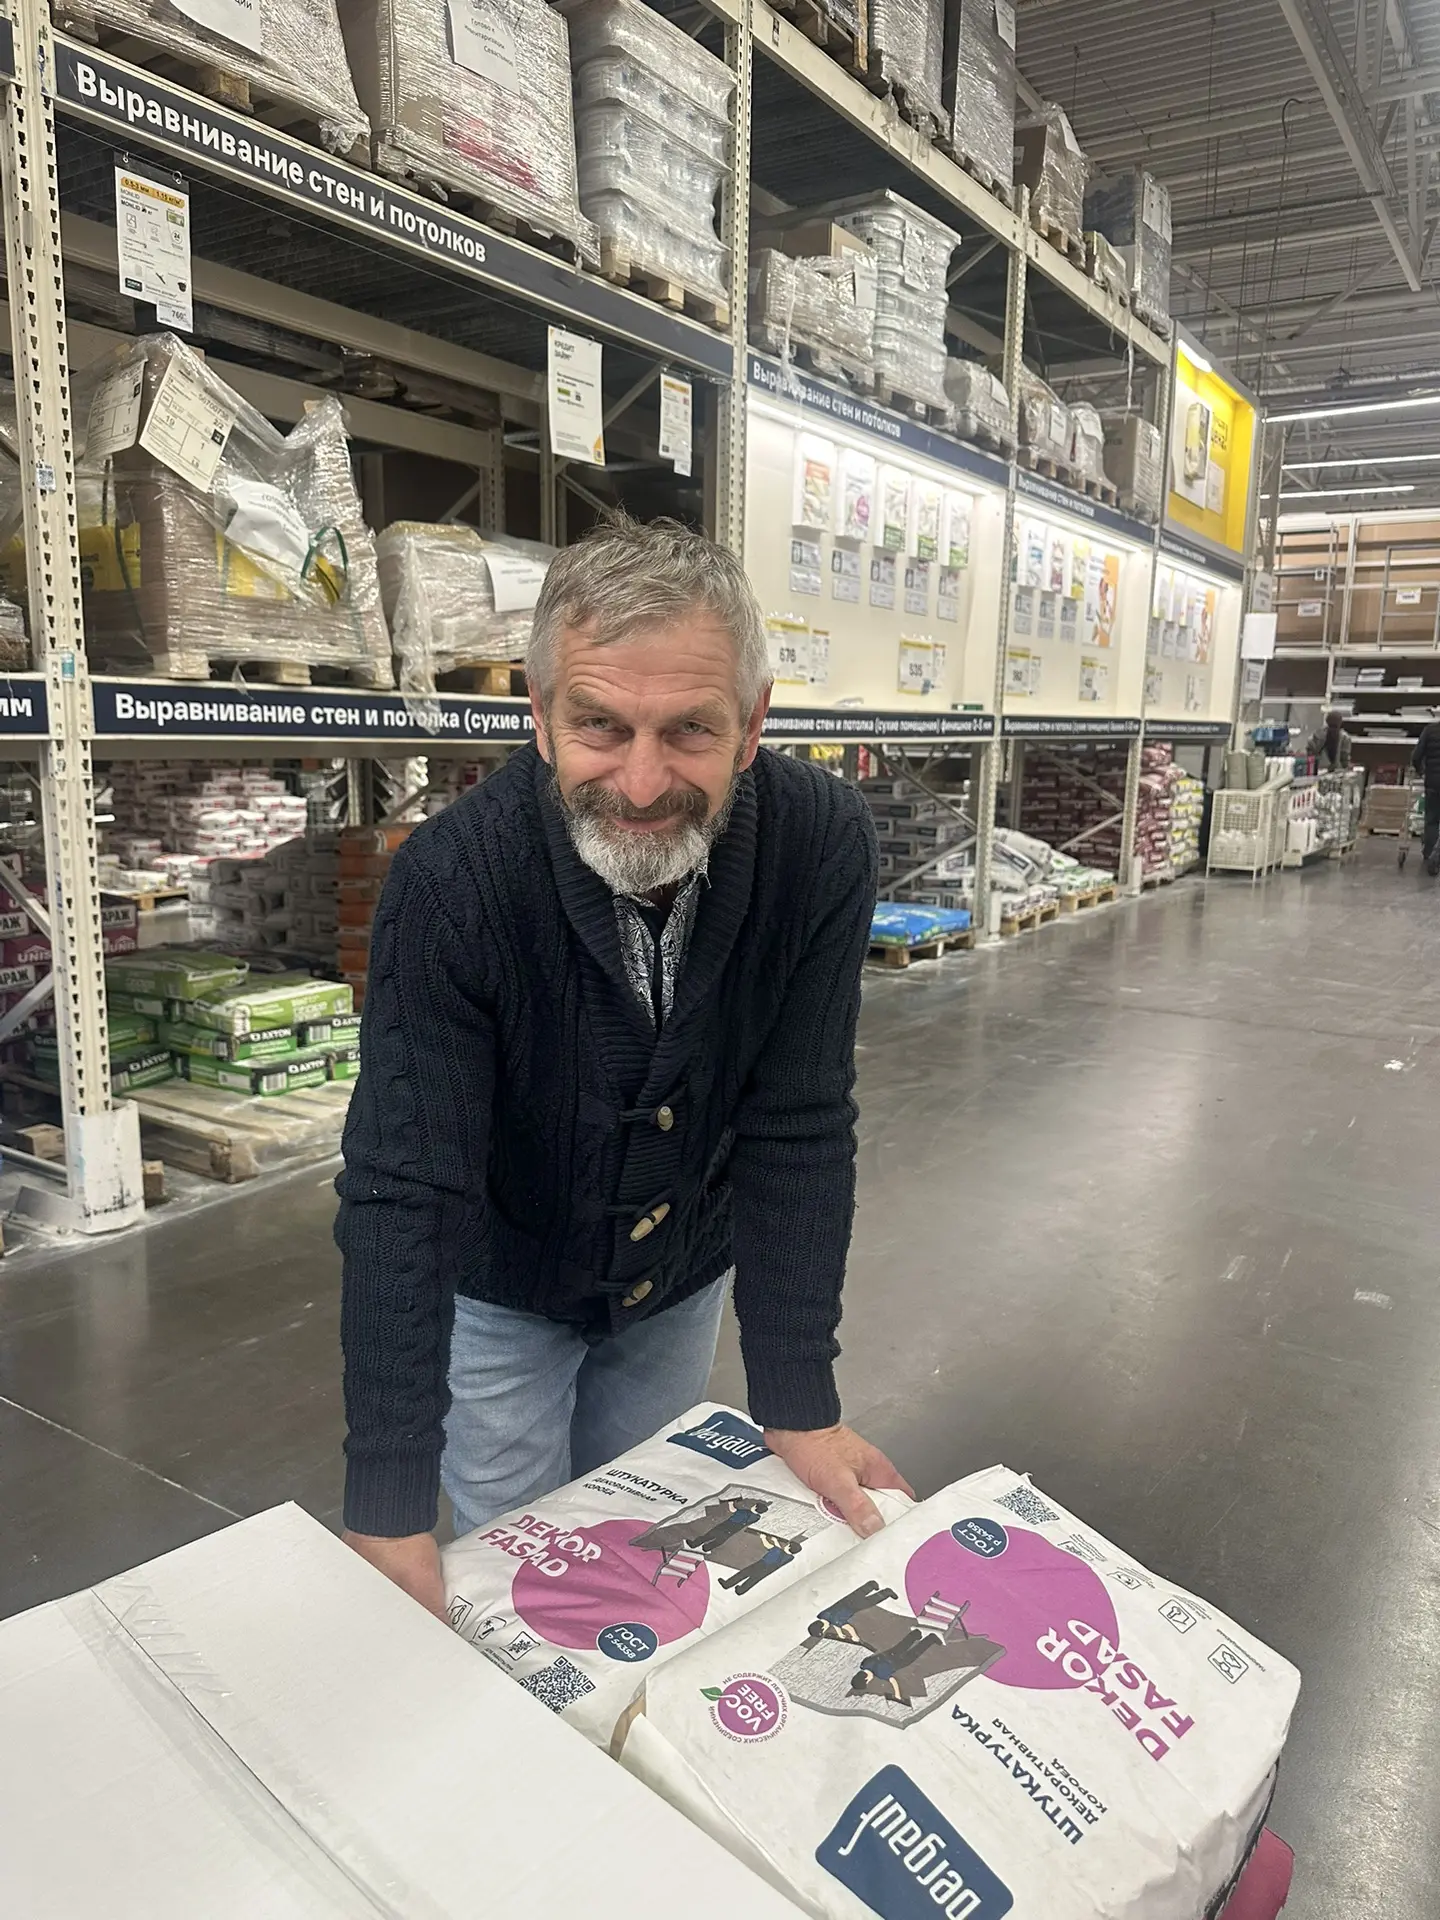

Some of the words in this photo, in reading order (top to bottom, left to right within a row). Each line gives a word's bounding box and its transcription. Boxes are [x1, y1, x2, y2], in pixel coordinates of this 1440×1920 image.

[76, 60, 304, 185] Выравнивание
[308, 170, 365, 212] стен
[370, 195, 385, 221] и
[389, 204, 487, 263] потолков
[753, 361, 830, 410] Выравнивание
[831, 398, 854, 419] стен
[854, 407, 861, 423] и
[861, 411, 901, 438] потолков
[115, 693, 306, 726] Выравнивание
[311, 706, 360, 726] стен
[365, 708, 378, 726] и
[383, 709, 460, 729] потолка
[464, 707, 520, 733] (сухие
[815, 719, 835, 731] стен
[836, 719, 842, 731] и
[842, 719, 874, 731] потолка
[689, 1420, 764, 1459] bergauf
[582, 1482, 616, 1497] КОРОЕД
[593, 1476, 658, 1503] ДЕКОРАТИВНАЯ
[605, 1468, 689, 1505] ШТУКАТУРКА
[509, 1514, 602, 1563] DEKOR
[957, 1528, 995, 1554] ГОСТ
[967, 1521, 994, 1541] 54358
[478, 1528, 569, 1577] FASAD
[611, 1638, 636, 1660] 54358
[614, 1626, 650, 1653] ГОСТ
[722, 1676, 733, 1685] НЕ
[732, 1672, 773, 1684] СОДЕРЖИТ
[1035, 1627, 1171, 1762] DEKOR
[1067, 1619, 1196, 1739] FASAD
[725, 1693, 762, 1732] VOC
[737, 1683, 776, 1720] FREE
[771, 1683, 788, 1713] ЛЕТУЧИХ
[708, 1705, 742, 1743] СОЕДИНЕНИЙ
[743, 1713, 788, 1744] ОРГАНИЧЕСКИХ
[951, 1704, 1084, 1845] ШТУКАТУРКА
[992, 1718, 1100, 1825] ДЕКОРАТИВНАЯ
[1051, 1758, 1109, 1814] КОРОЕД
